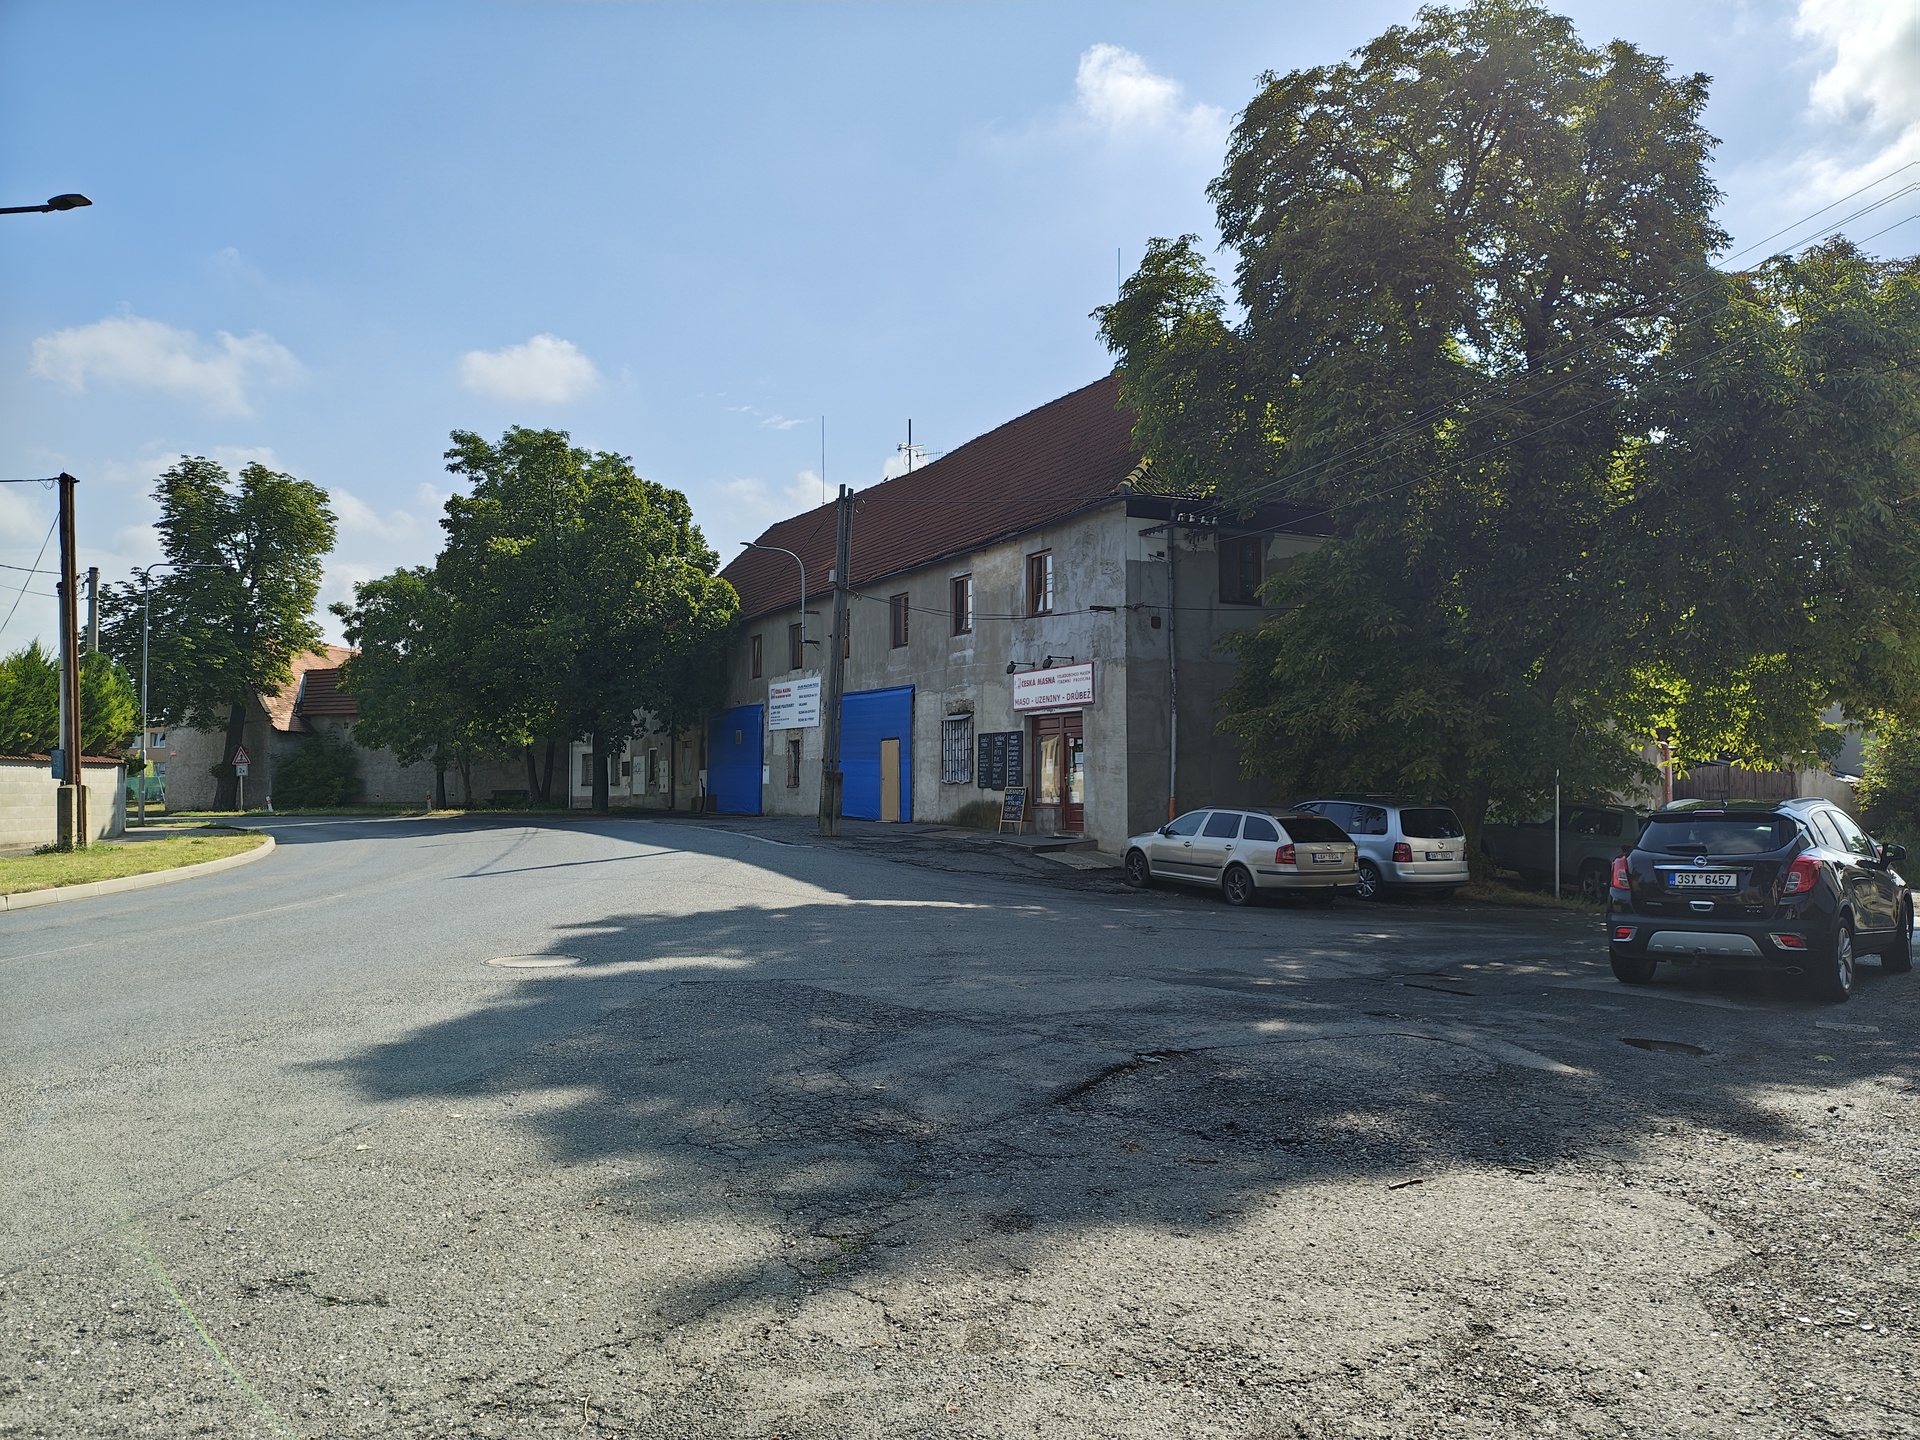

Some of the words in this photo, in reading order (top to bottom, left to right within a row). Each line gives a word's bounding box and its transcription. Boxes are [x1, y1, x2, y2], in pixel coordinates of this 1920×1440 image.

[1037, 676, 1055, 685] MASNA
[1015, 698, 1030, 706] MASO
[1034, 694, 1061, 704] UZENINY
[1066, 688, 1091, 701] DRŮBEŽ
[1677, 874, 1697, 884] 3SX
[1705, 874, 1732, 885] 6457
